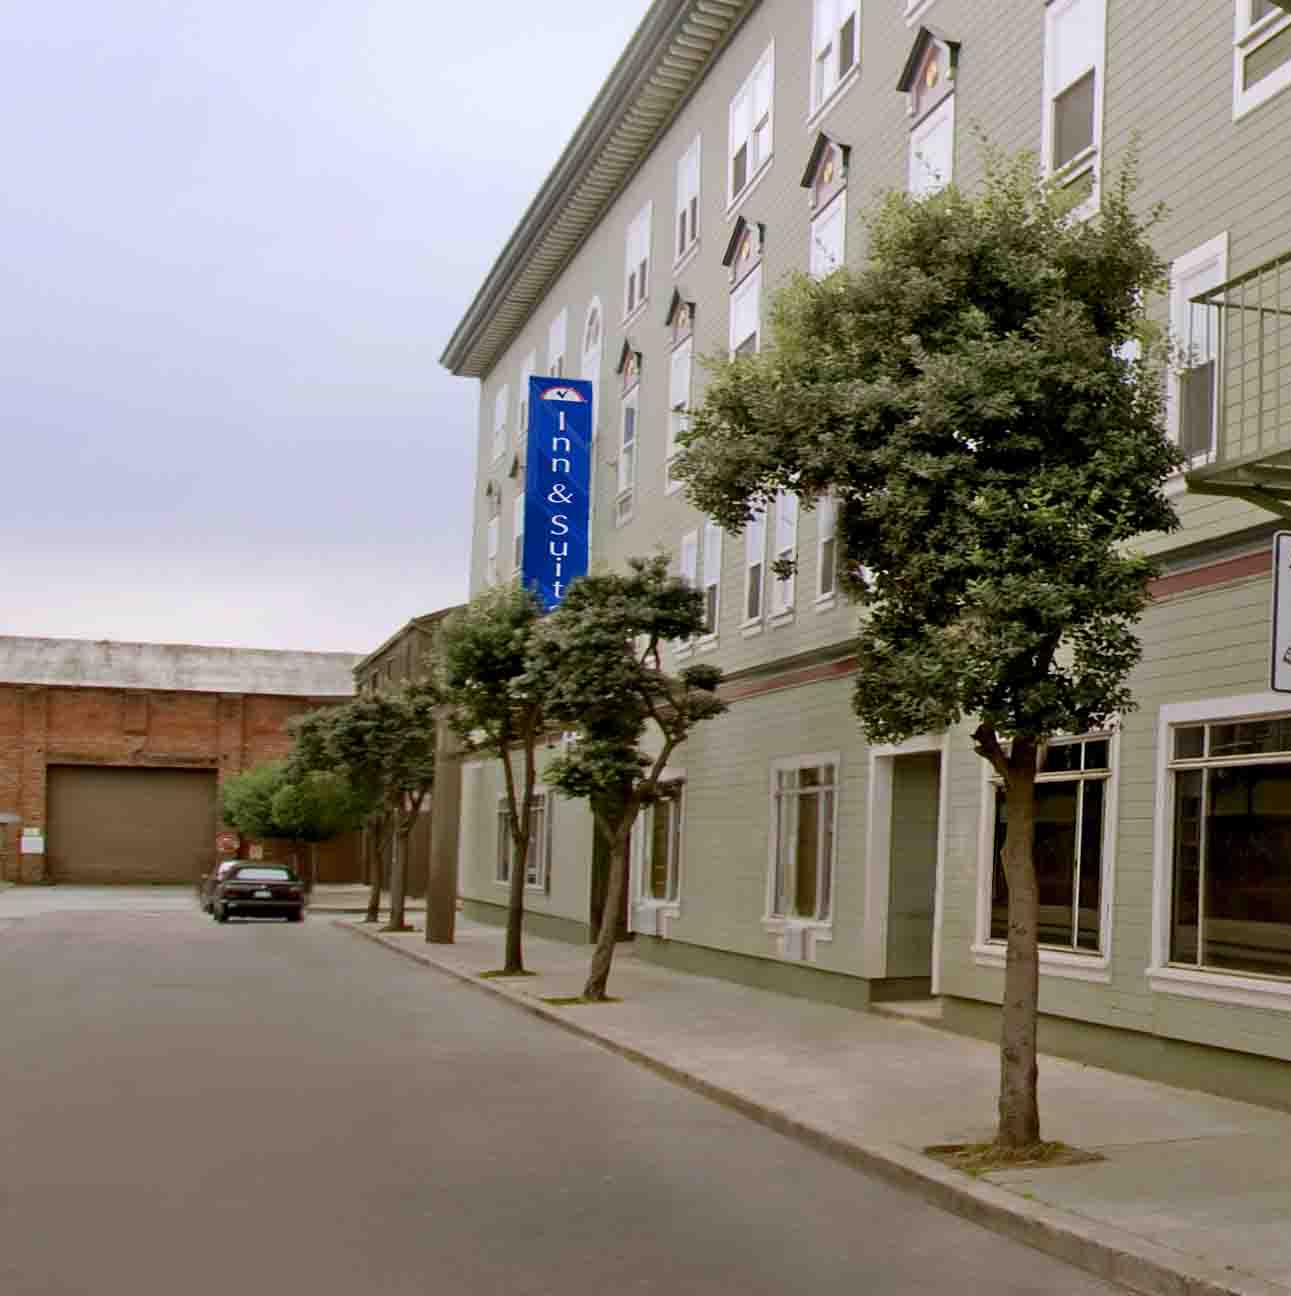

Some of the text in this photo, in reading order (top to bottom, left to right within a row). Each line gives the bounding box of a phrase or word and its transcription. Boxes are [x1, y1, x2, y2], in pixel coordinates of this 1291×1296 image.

[547, 410, 574, 611] Inn & Suit
